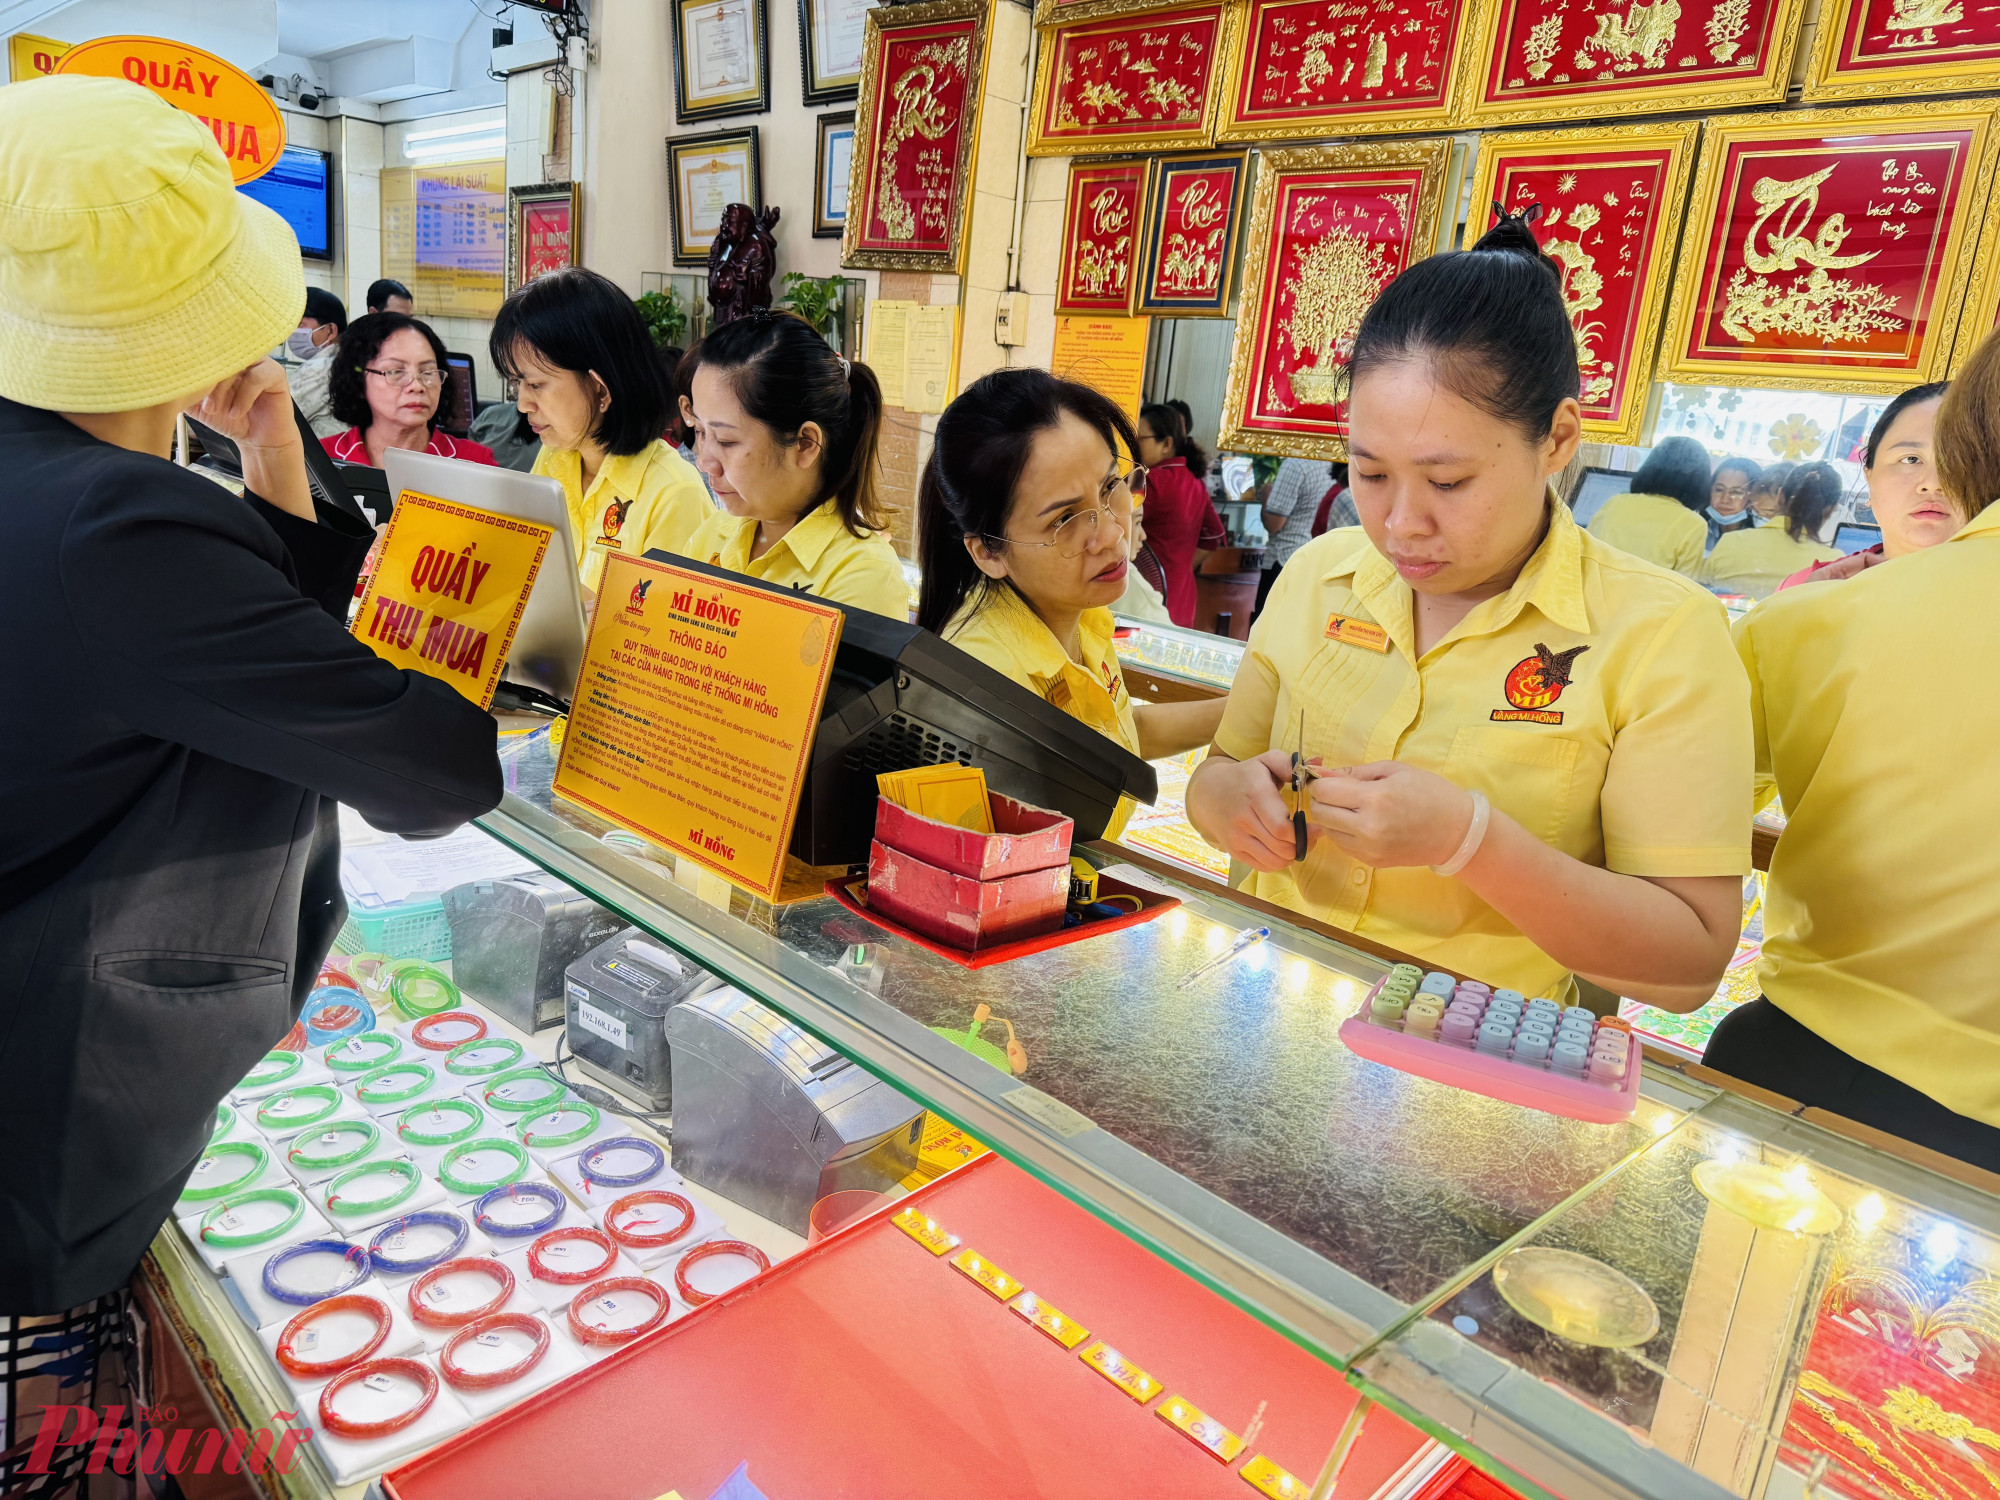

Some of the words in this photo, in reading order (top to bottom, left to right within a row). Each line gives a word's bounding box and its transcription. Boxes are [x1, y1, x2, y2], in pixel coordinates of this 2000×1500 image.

[1327, 1, 1369, 19] Mừng
[1078, 47, 1098, 64] Mã
[1139, 32, 1169, 47] Thành
[1179, 32, 1203, 56] Công
[121, 56, 220, 98] QUẦY
[422, 177, 449, 192] KHUNG
[1516, 182, 1536, 200] Tâm
[1630, 180, 1650, 199] Tâm
[1624, 205, 1644, 218] An
[1614, 265, 1633, 278] An
[410, 541, 491, 604] QUẦY
[693, 593, 741, 627] HỒNG
[368, 595, 424, 651] THU
[419, 615, 488, 679] MUA
[669, 629, 702, 651] THÔNG
[704, 640, 727, 659] BÁO
[623, 638, 639, 651] QUY
[639, 643, 660, 659] TRÌNH
[661, 651, 679, 666] GIAO
[679, 657, 698, 673] DỊCH
[700, 663, 713, 678] VỚI
[713, 669, 742, 687] KHÁCH
[742, 678, 766, 696] HÀNG
[610, 649, 621, 662] TẠI
[621, 652, 636, 666] CÁC
[636, 656, 651, 672] CỬA
[652, 663, 673, 680] HÀNG
[674, 671, 700, 690] TRONG
[701, 681, 713, 696] HỆ
[714, 685, 741, 704] THỐNG
[742, 696, 753, 708] MI
[753, 698, 778, 718] HỒNG
[1511, 692, 1552, 707] MH
[1492, 710, 1518, 720] VÀNG
[1519, 712, 1532, 721] MI
[1533, 711, 1561, 724] HỒNG
[703, 835, 735, 860] HỒNG
[581, 1010, 621, 1037] 192.168.1.49
